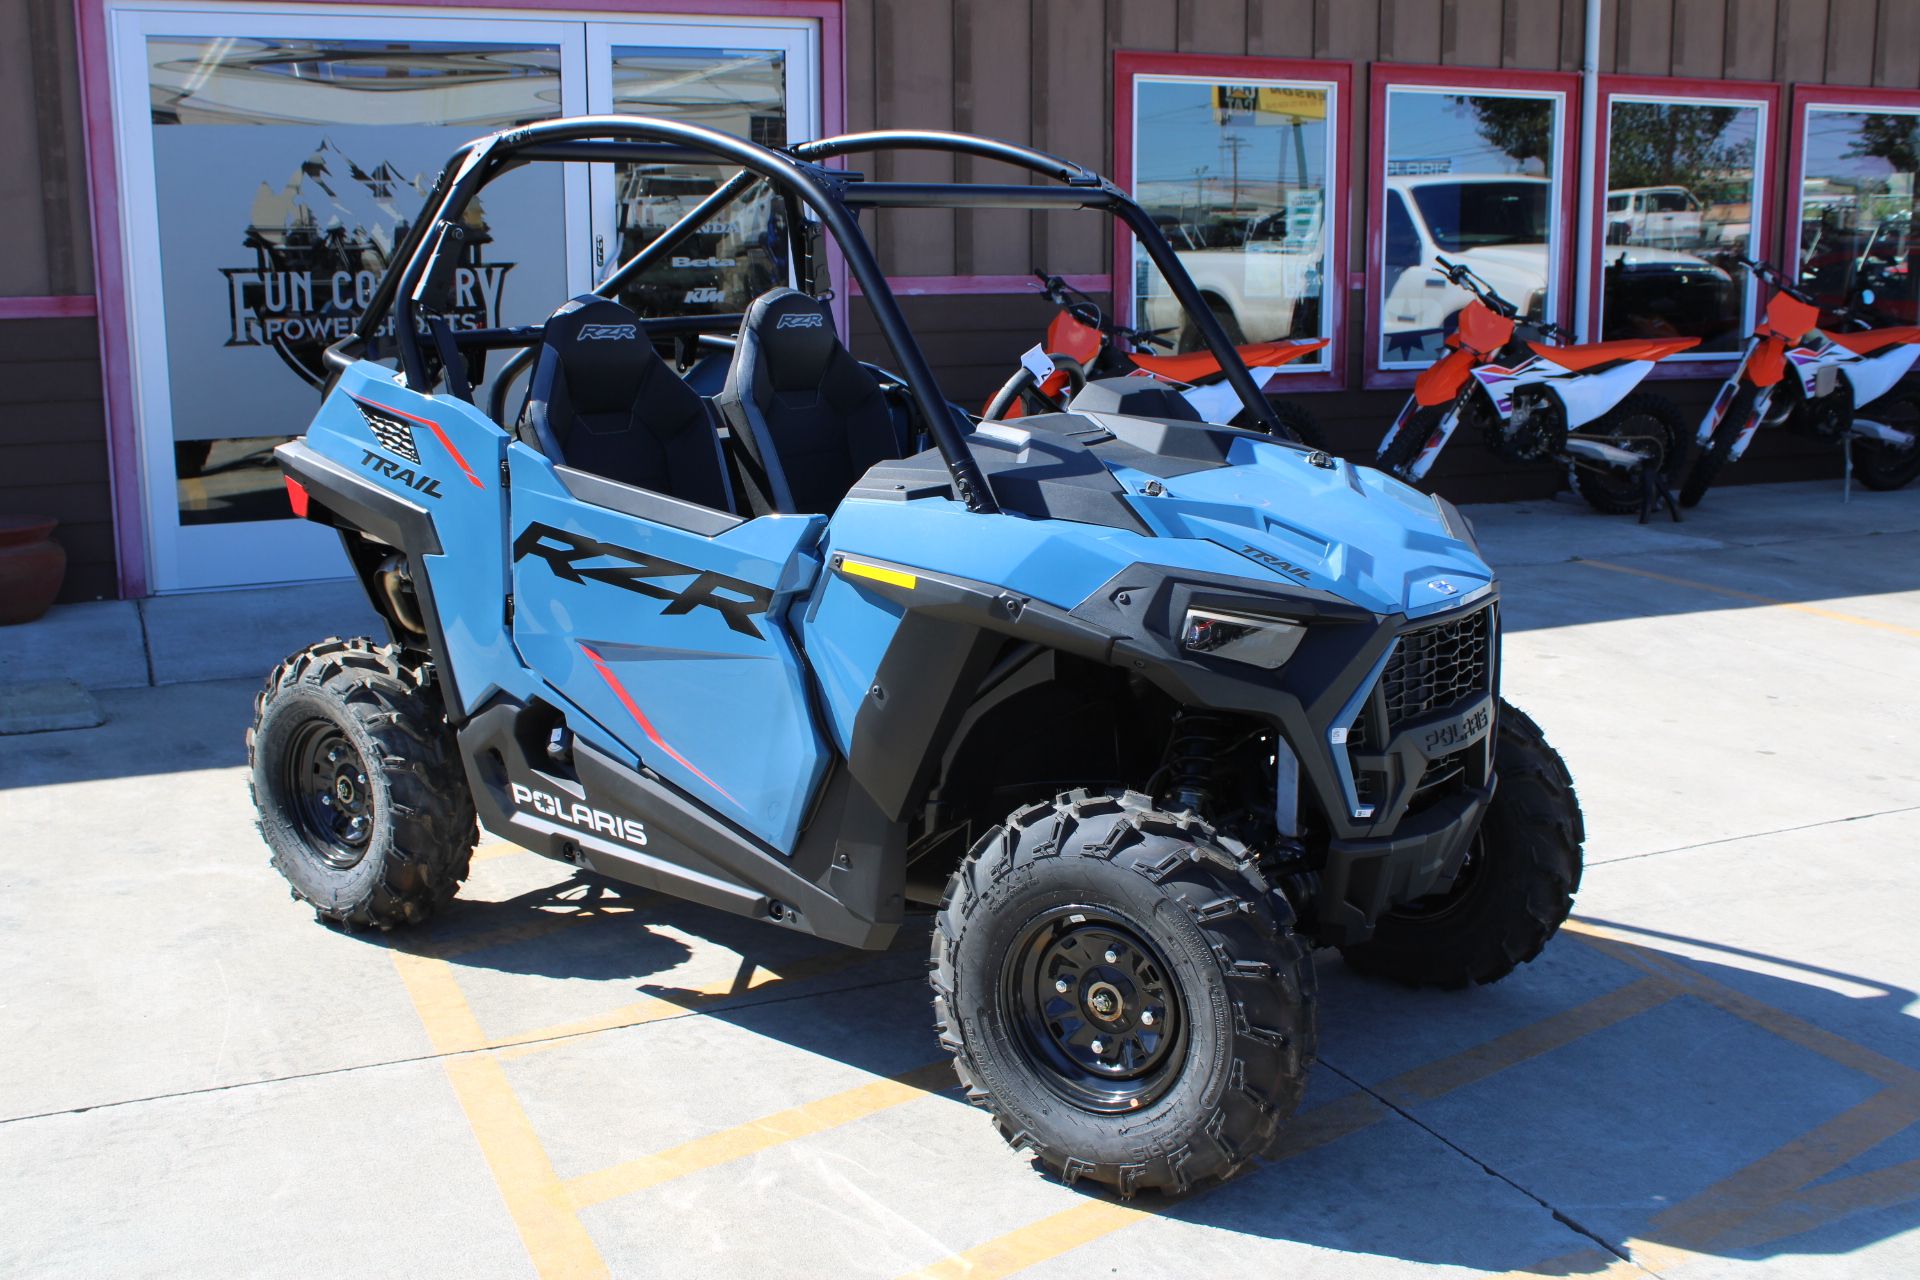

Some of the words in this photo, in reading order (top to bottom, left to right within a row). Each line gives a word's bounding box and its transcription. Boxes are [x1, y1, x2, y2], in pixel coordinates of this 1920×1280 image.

[672, 256, 736, 268] Beta
[231, 270, 313, 343] FUN
[331, 265, 504, 331] CORY
[684, 287, 726, 304] KTM
[266, 313, 477, 341] POWETS
[577, 324, 637, 341] RZR
[776, 313, 823, 330] RZR
[361, 448, 443, 499] TRAIL
[1242, 545, 1312, 580] TRAIL
[513, 521, 775, 641] RZR
[1425, 707, 1488, 752] POLARIS
[511, 783, 647, 845] POLARIS
